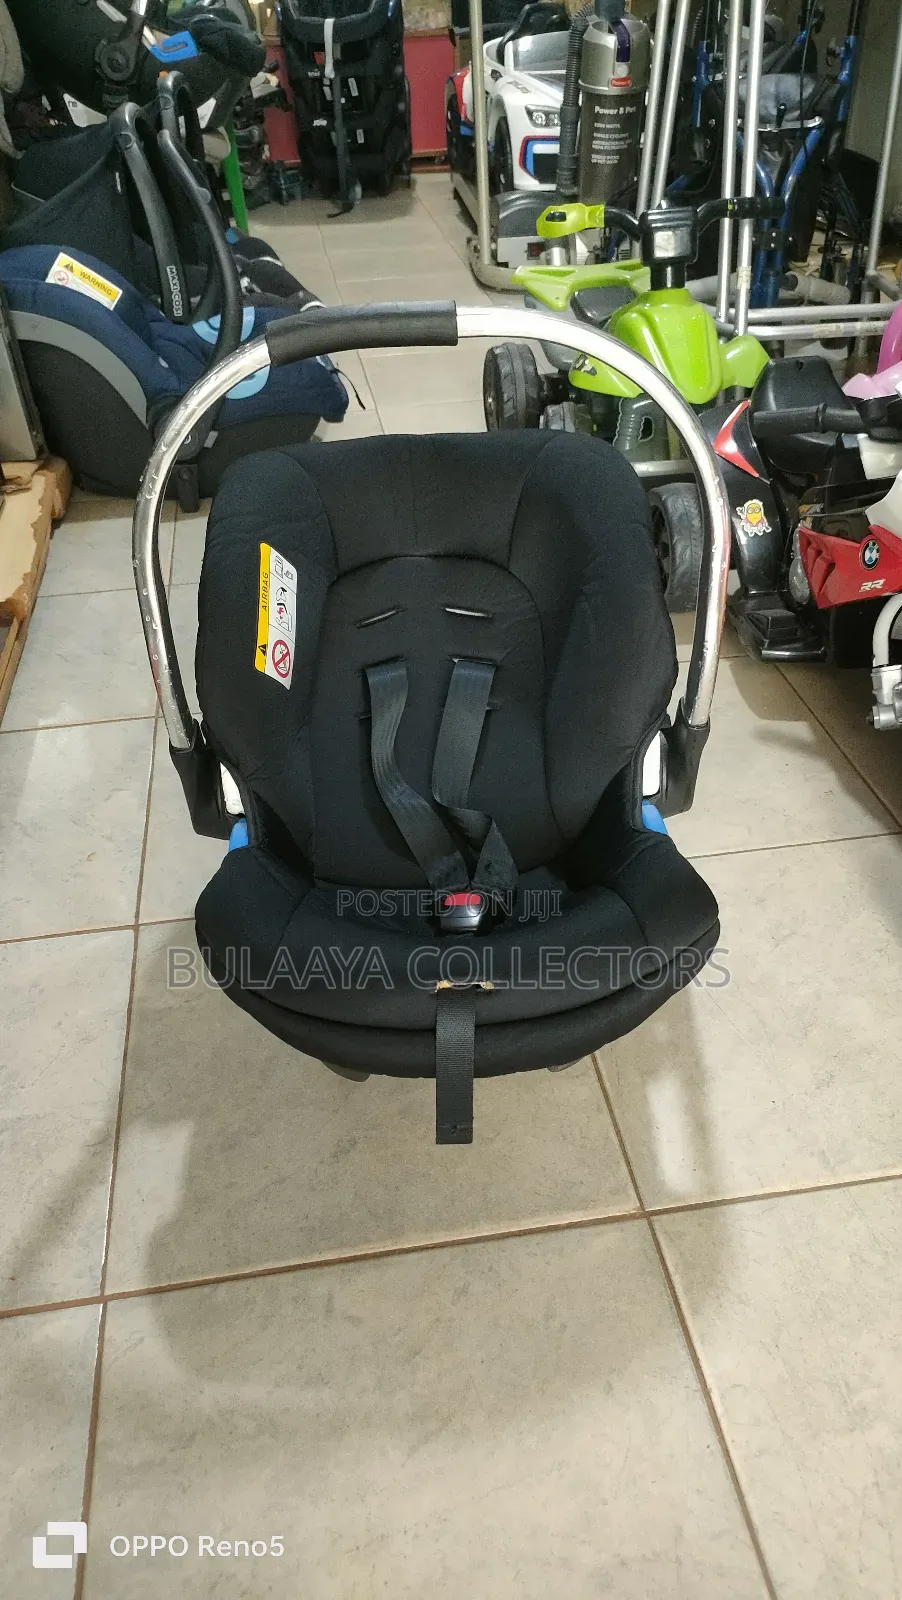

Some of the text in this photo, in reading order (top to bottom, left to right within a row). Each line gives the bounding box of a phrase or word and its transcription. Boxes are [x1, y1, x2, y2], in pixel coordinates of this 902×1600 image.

[594, 105, 618, 115] Power
[80, 270, 113, 296] WARNING
[859, 579, 886, 592] RR
